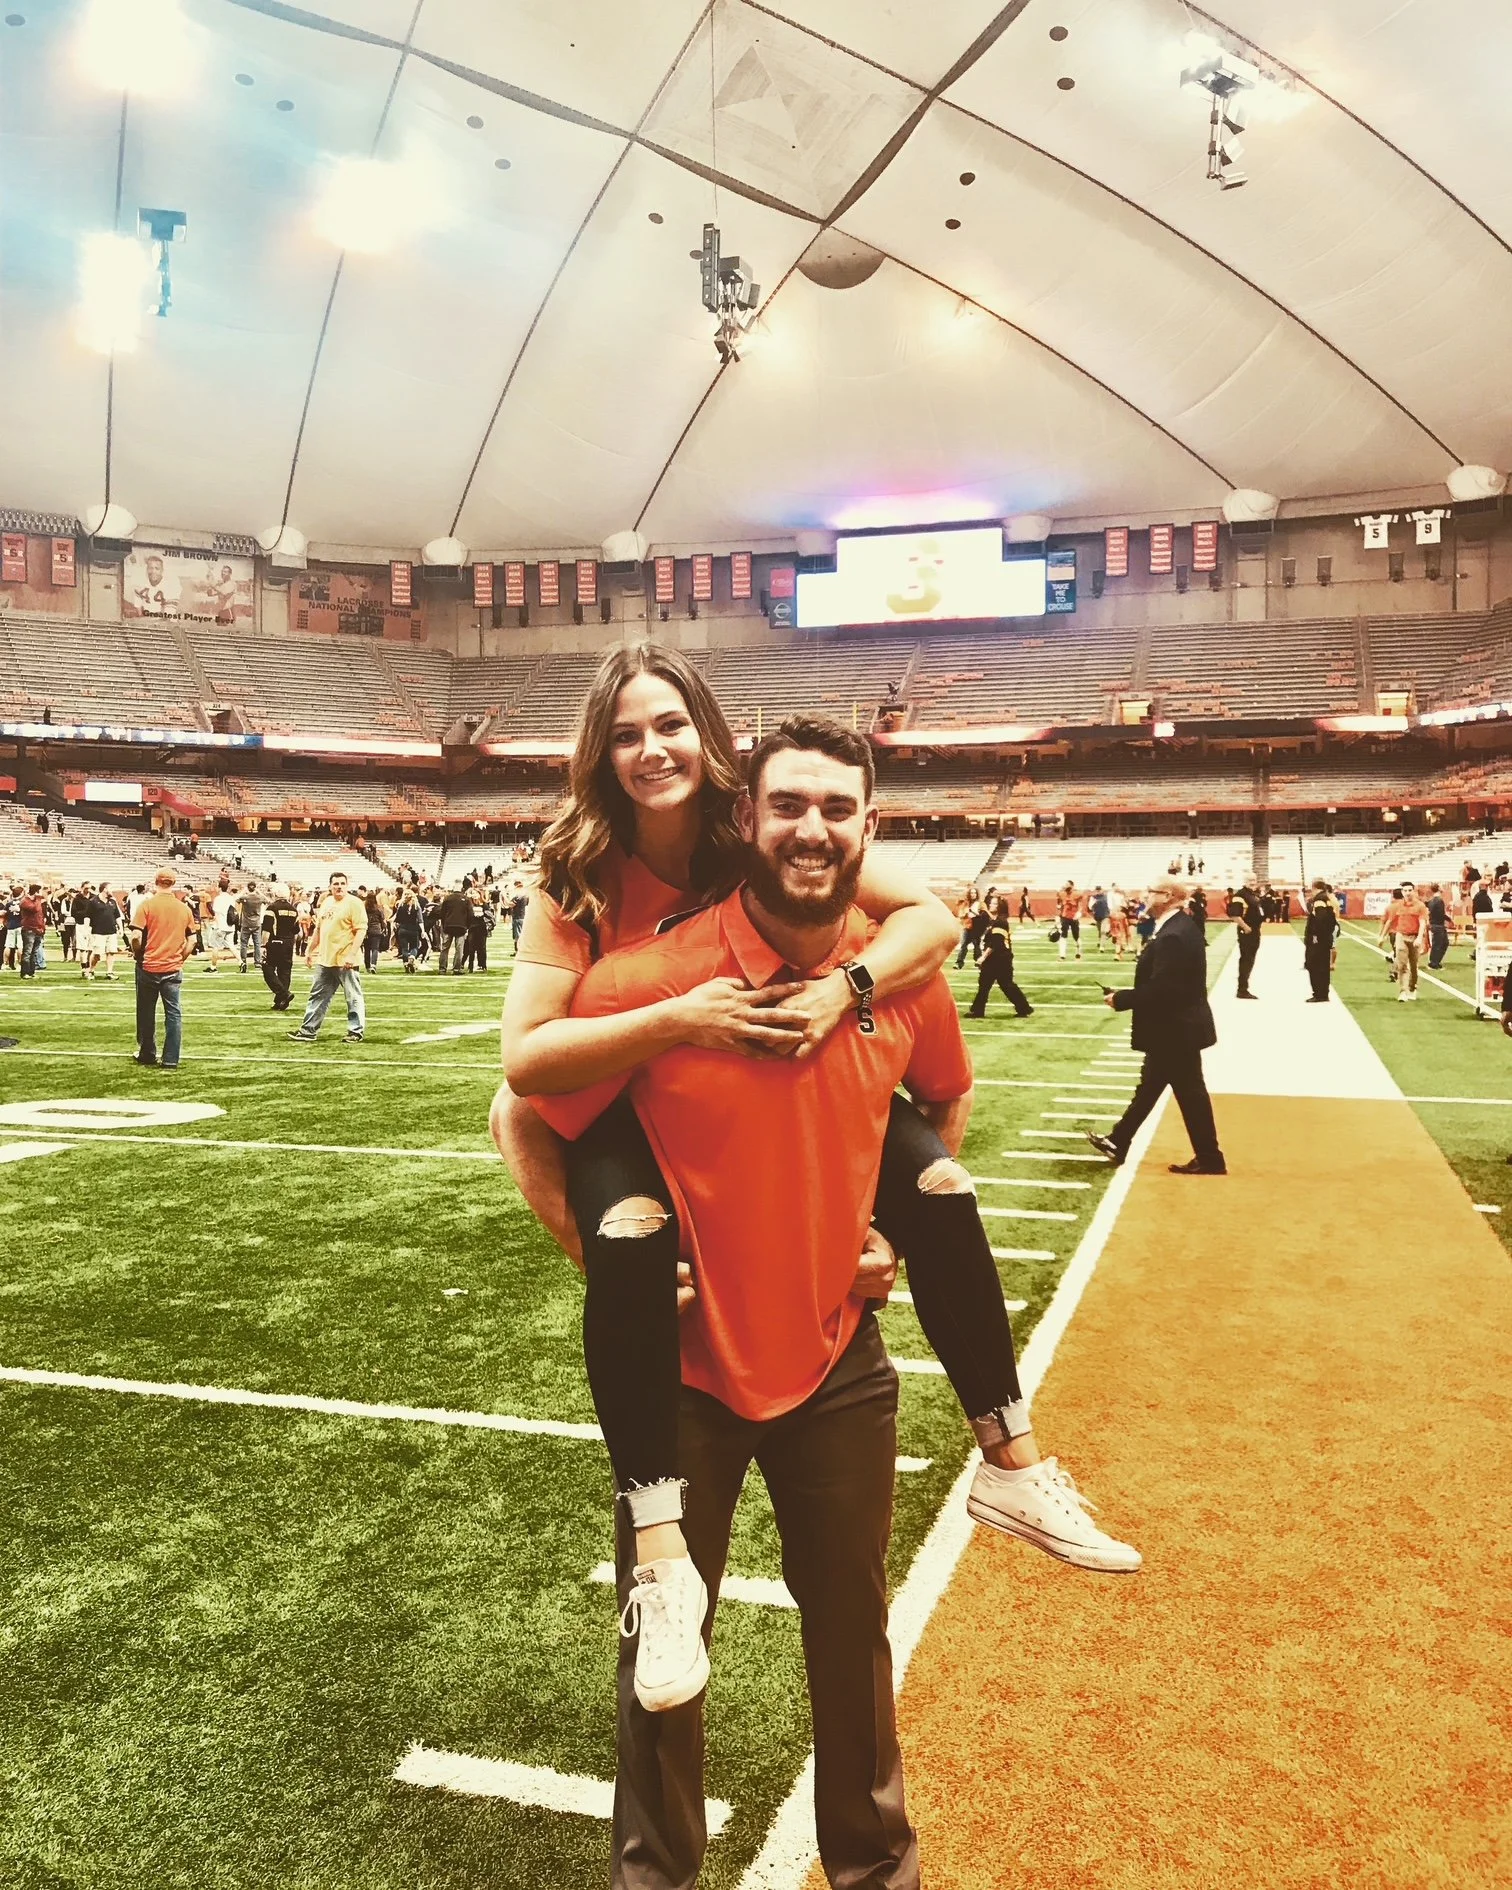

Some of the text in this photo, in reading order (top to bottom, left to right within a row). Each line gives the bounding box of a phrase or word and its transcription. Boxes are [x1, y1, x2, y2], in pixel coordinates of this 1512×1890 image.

[1372, 528, 1379, 538] 5
[1424, 523, 1432, 534] 9
[162, 549, 219, 561] JIM BROWN
[337, 597, 384, 608] LACROSSE
[1047, 602, 1074, 611] CROUSE
[308, 601, 411, 618] NATIONAL AMPIONS
[143, 610, 182, 620] Greatest
[184, 613, 213, 623] Player
[857, 1007, 877, 1035] S
